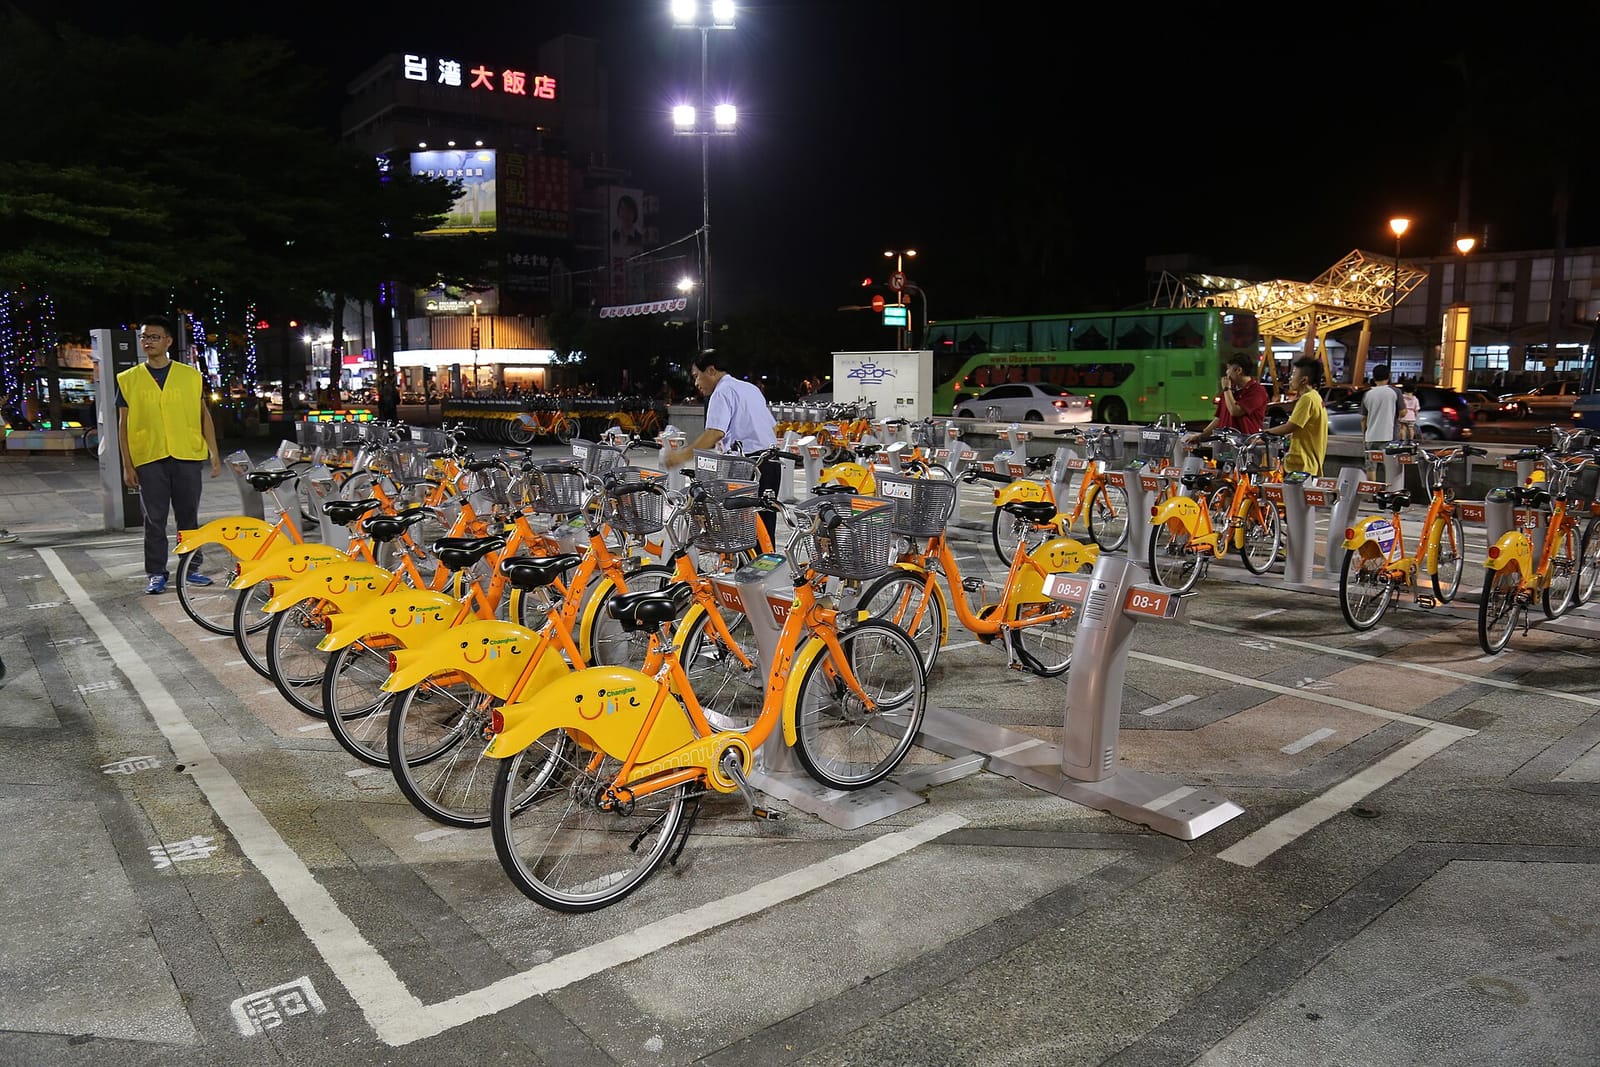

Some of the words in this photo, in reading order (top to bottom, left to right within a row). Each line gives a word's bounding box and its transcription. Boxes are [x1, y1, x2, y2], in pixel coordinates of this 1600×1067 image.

[1267, 491, 1281, 499] 24-1
[1307, 495, 1323, 503] 24-2
[1464, 509, 1482, 518] 25-1
[1057, 583, 1082, 597] 08-2
[722, 592, 742, 606] 07-1
[1132, 595, 1161, 610] 08-1
[607, 687, 636, 697] Changhua
